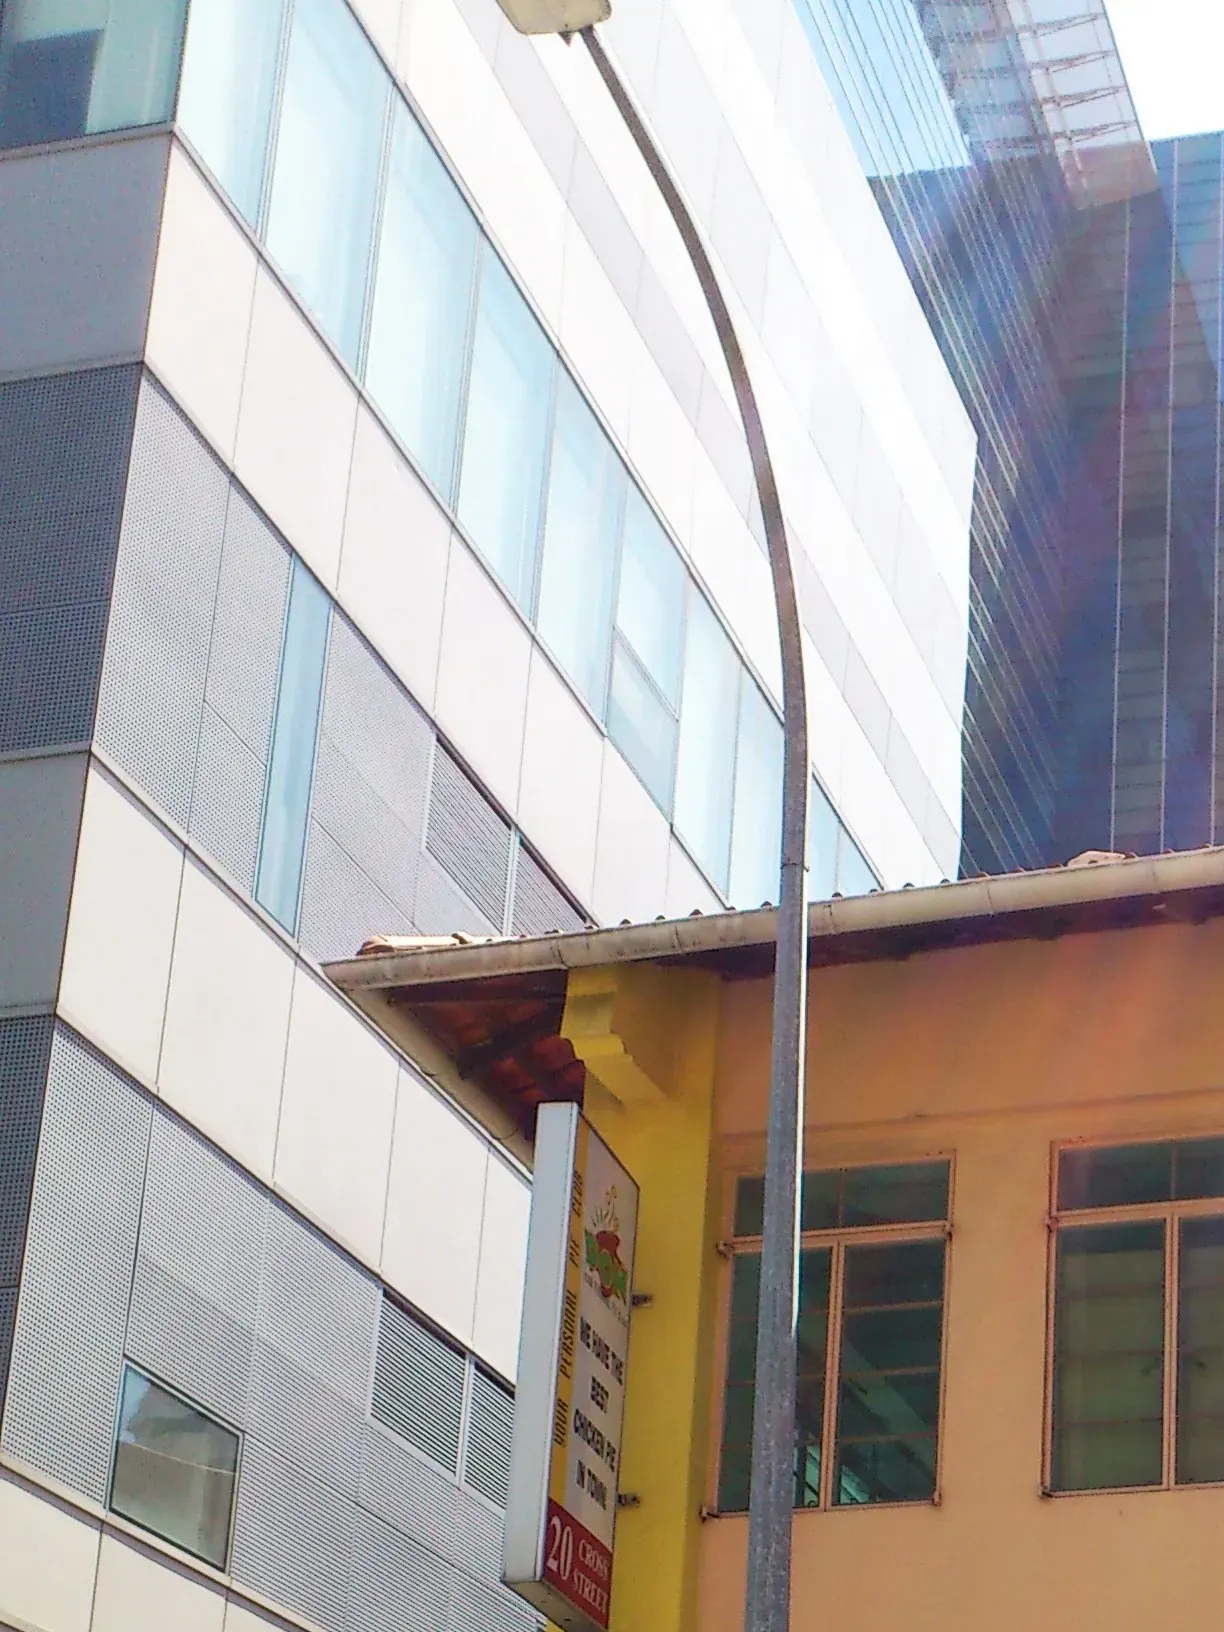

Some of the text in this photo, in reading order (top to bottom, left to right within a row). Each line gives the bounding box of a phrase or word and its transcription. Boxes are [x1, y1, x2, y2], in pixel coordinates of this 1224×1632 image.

[573, 1408, 604, 1459] CHICKEN
[546, 1515, 573, 1580] 20
[578, 1539, 609, 1581] CROSS
[573, 1567, 609, 1615] STREET
